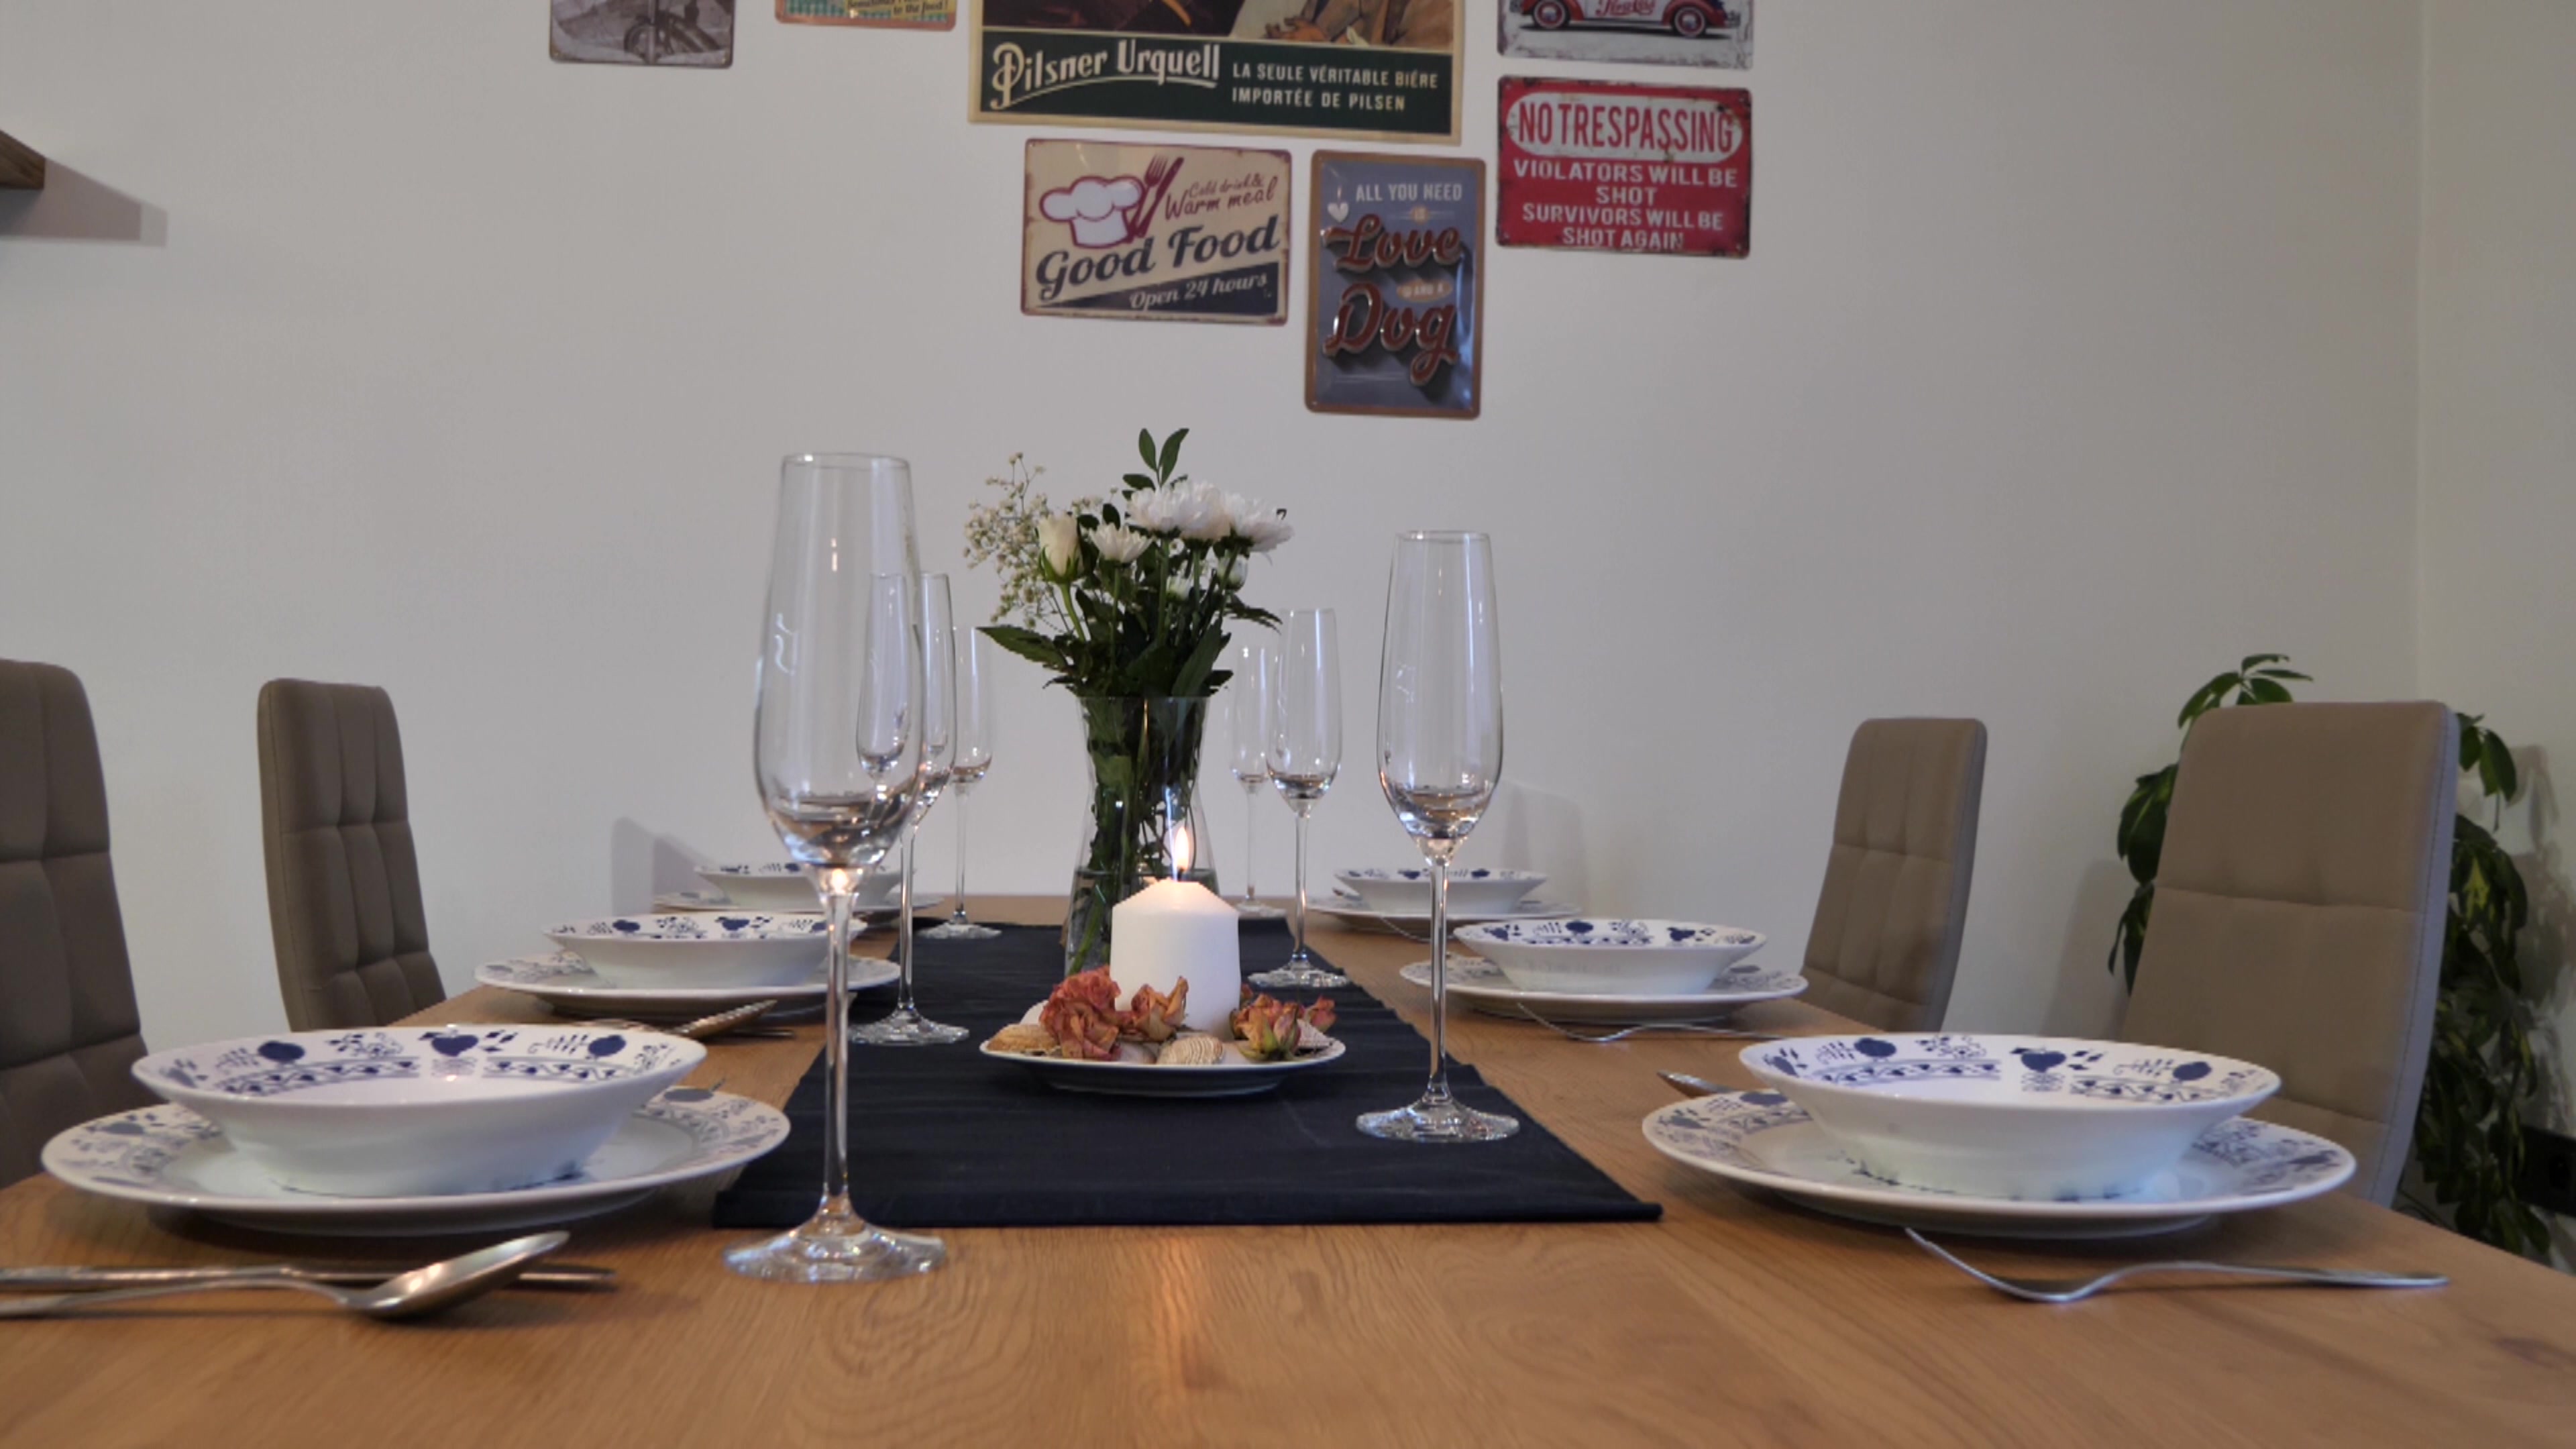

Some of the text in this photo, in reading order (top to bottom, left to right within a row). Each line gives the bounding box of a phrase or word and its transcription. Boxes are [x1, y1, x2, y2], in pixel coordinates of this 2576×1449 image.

[989, 39, 1220, 110] Pilsner Urquell
[1232, 63, 1250, 78] LA
[1256, 64, 1304, 81] SEULE
[1309, 64, 1389, 87] VÉRITABLE
[1232, 87, 1405, 111] IMPORTÉE DE PILSEN
[1518, 102, 1733, 154] NO TRESPASSING
[1513, 159, 1737, 188] VIOLATORS WILL BE
[1165, 175, 1278, 221] Warm meal
[1356, 183, 1462, 202] ALL YOU NEED
[1596, 186, 1658, 205] SHOT
[1522, 203, 1723, 231] SURVIVORS WILL BE
[1321, 213, 1462, 272] Love
[1562, 227, 1684, 250] SHOT AGAIN
[1036, 214, 1281, 301] Good Food
[1130, 272, 1268, 311] Open 24 hours
[1322, 282, 1459, 387] Dog
